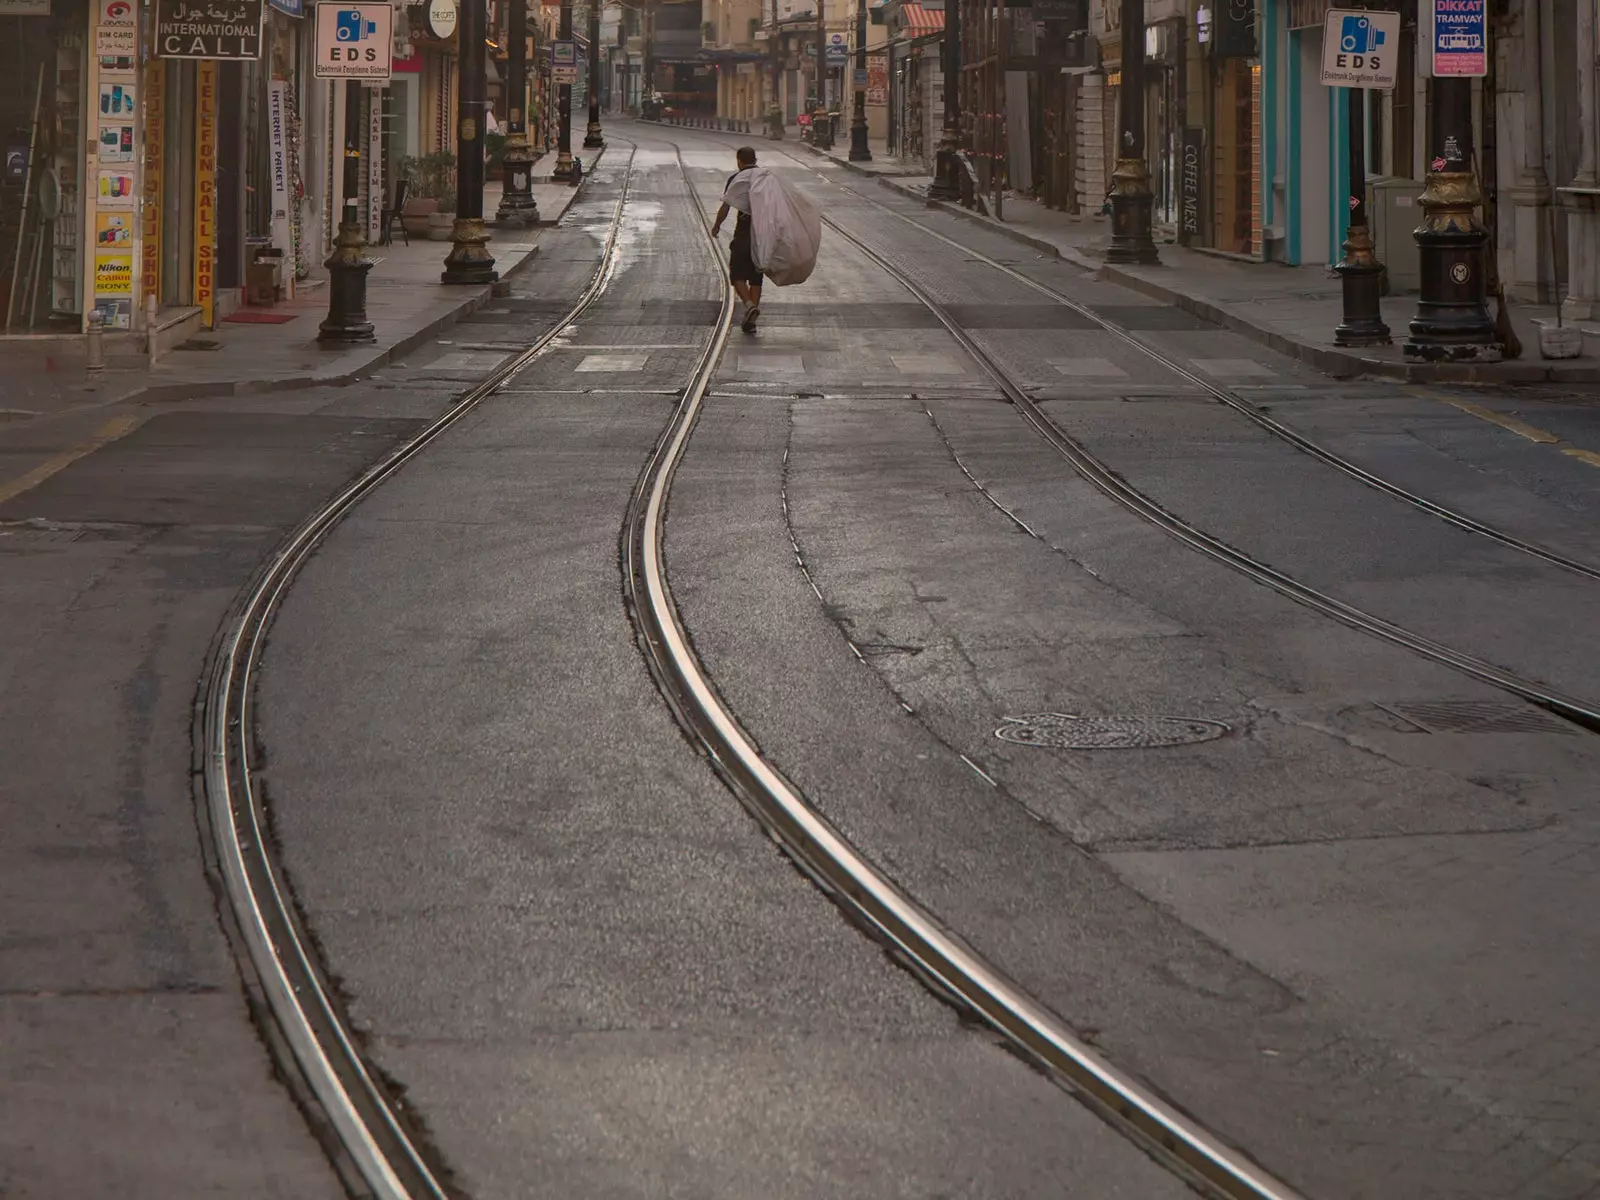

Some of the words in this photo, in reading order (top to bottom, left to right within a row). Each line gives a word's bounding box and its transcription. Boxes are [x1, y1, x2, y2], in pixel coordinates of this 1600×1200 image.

[173, 2, 203, 21] جوال
[207, 3, 246, 22] شريحة
[1437, 0, 1482, 11] DİKKAT
[1436, 15, 1482, 23] TRAMVAY
[160, 22, 257, 37] INTERNATIONAL
[165, 36, 254, 55] CALL
[331, 48, 376, 61] EDS
[1336, 54, 1380, 69] EDS
[200, 71, 212, 172] TELEFON
[272, 90, 282, 148] INTERNET
[1185, 144, 1198, 193] COFFEE
[200, 181, 212, 236] CALL
[1184, 195, 1198, 233] MESE
[98, 264, 130, 272] Nikon
[198, 246, 211, 302] SHOP
